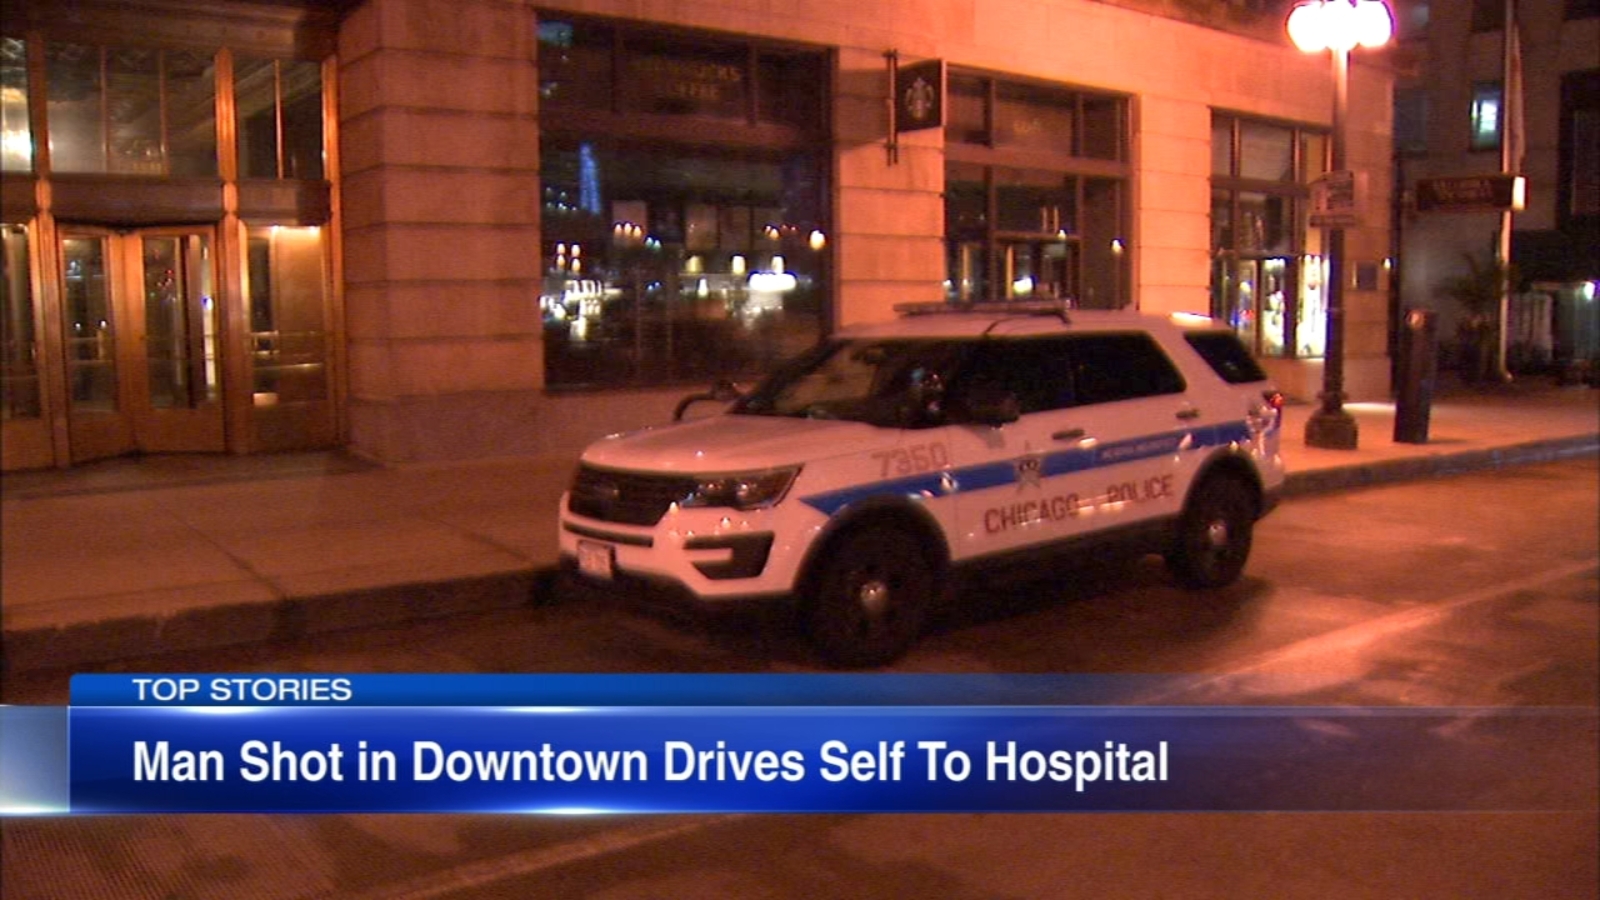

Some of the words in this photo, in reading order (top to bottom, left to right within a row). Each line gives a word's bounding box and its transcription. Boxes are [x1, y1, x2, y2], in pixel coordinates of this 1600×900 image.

[871, 441, 949, 478] 7350
[983, 492, 1080, 534] CHICAGO
[1106, 473, 1175, 504] POLICE
